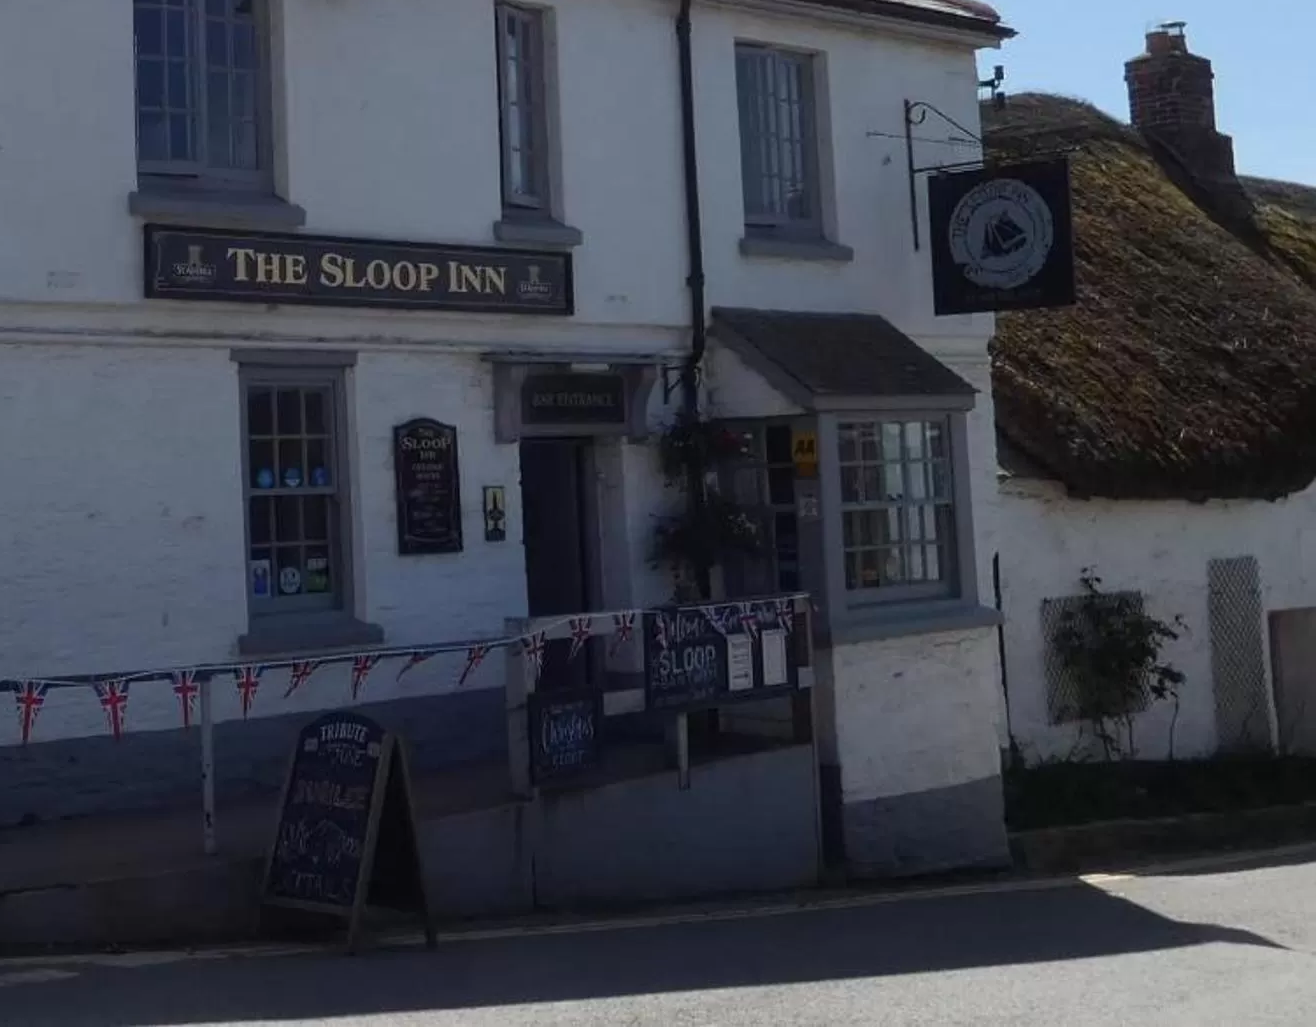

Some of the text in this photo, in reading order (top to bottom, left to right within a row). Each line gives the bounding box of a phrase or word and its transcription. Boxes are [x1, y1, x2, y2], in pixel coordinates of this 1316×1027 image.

[227, 248, 308, 286] THE
[320, 253, 440, 293] SLOOP
[447, 260, 507, 296] INN
[401, 436, 452, 451] SLOOP
[795, 439, 815, 458] AA
[658, 645, 716, 678] SLOOP
[319, 723, 369, 744] TRIBUTE
